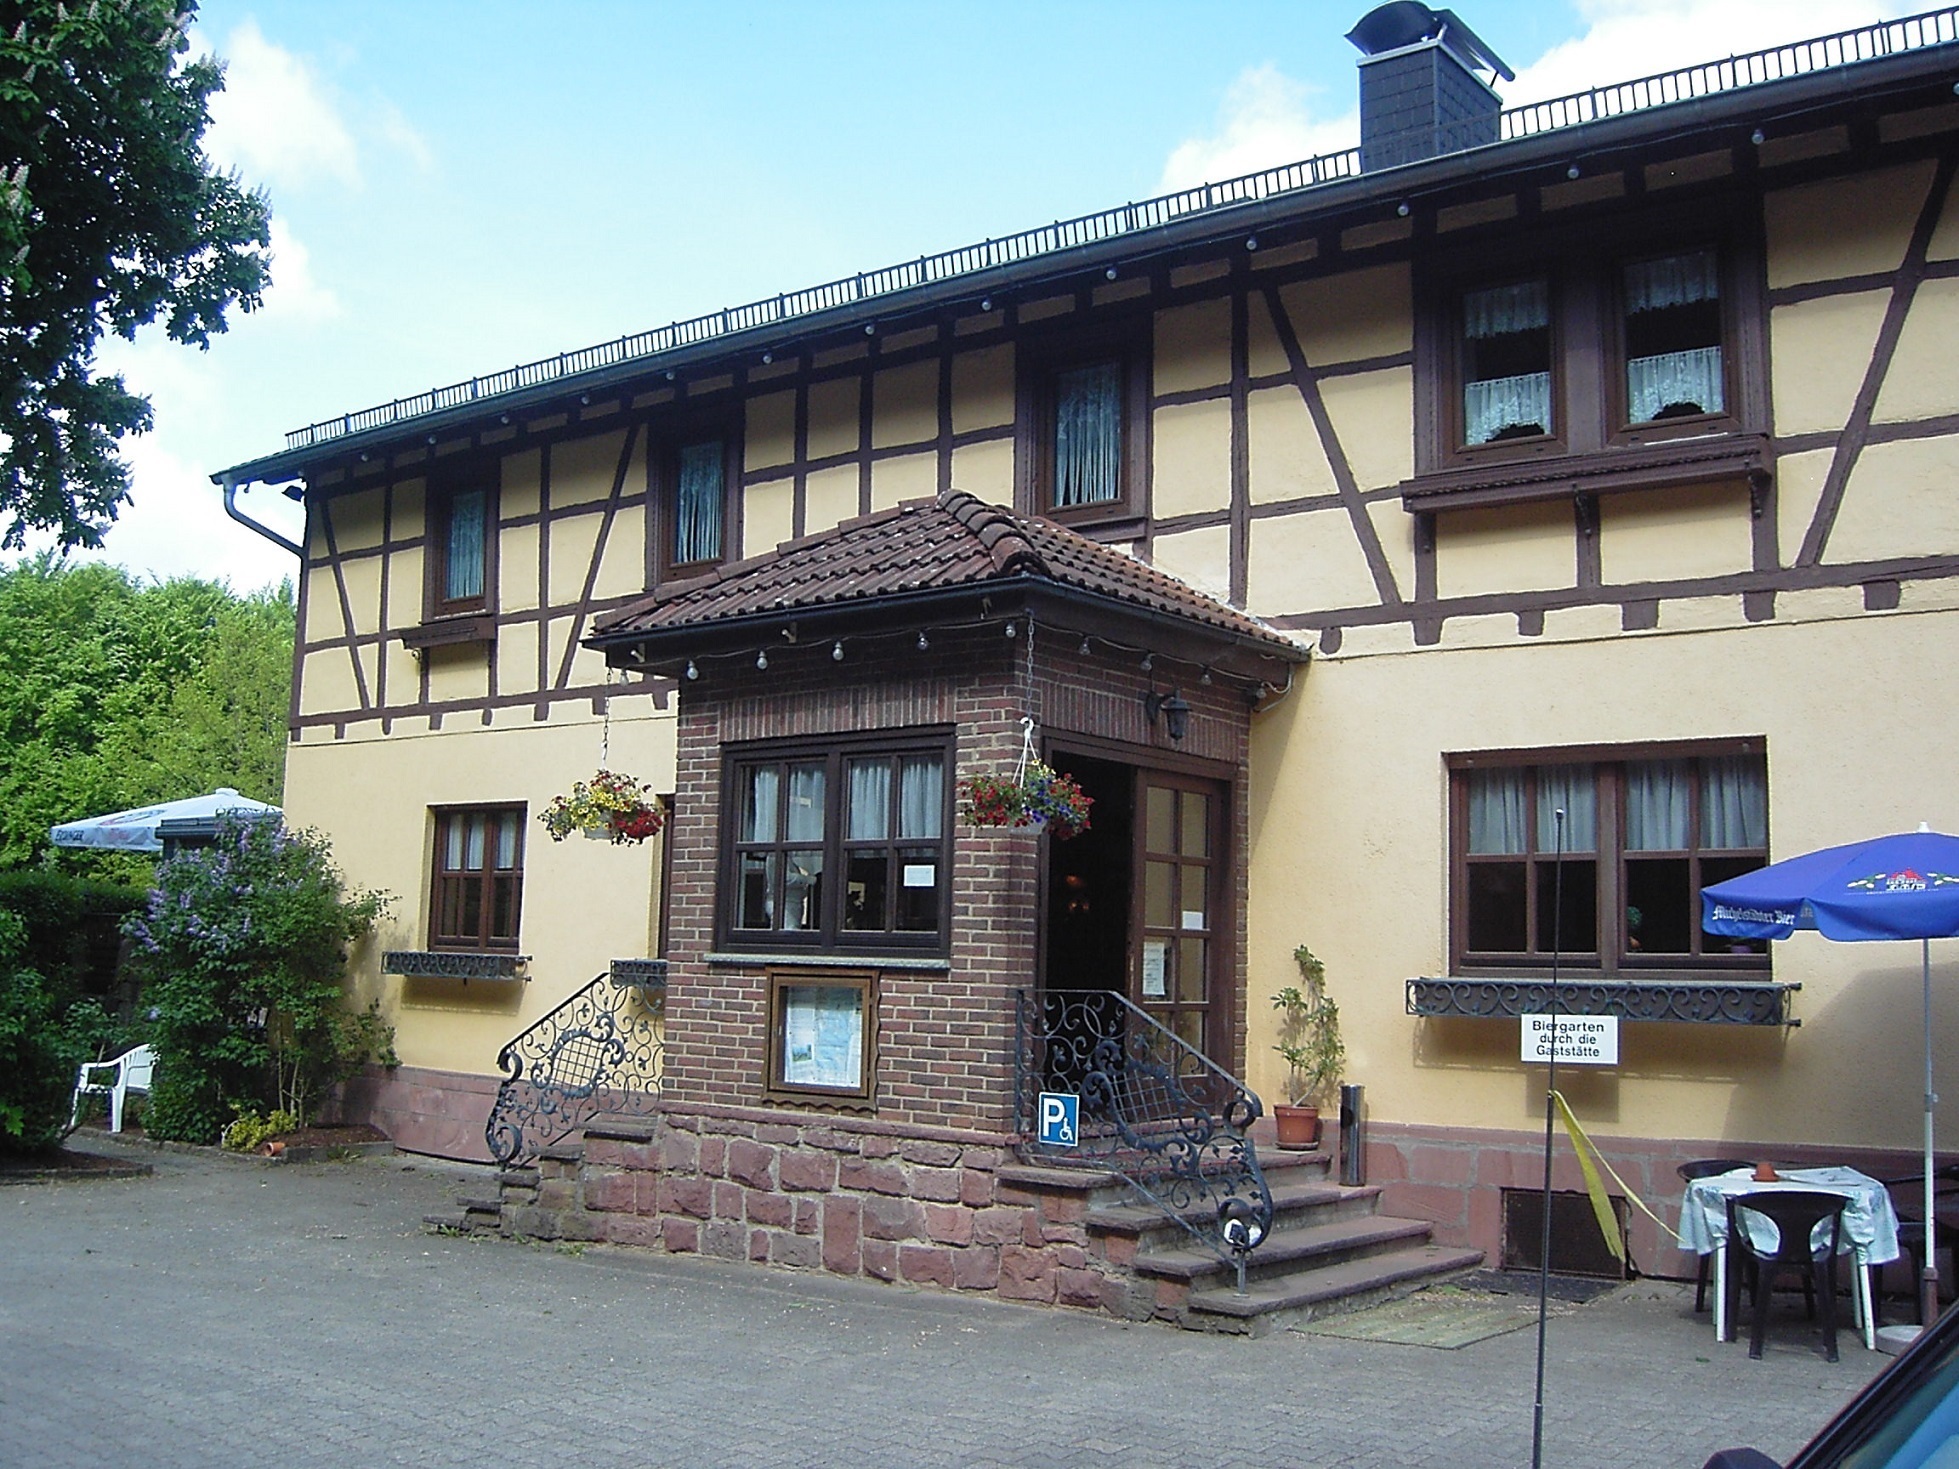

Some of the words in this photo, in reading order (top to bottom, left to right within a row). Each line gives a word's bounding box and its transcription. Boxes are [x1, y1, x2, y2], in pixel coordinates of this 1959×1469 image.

[1774, 908, 1796, 925] Bier
[1532, 1020, 1604, 1033] Biergarten
[1539, 1033, 1573, 1044] durch
[1578, 1034, 1597, 1045] die
[1536, 1045, 1600, 1057] Gaststätte
[1043, 1098, 1066, 1137] P
